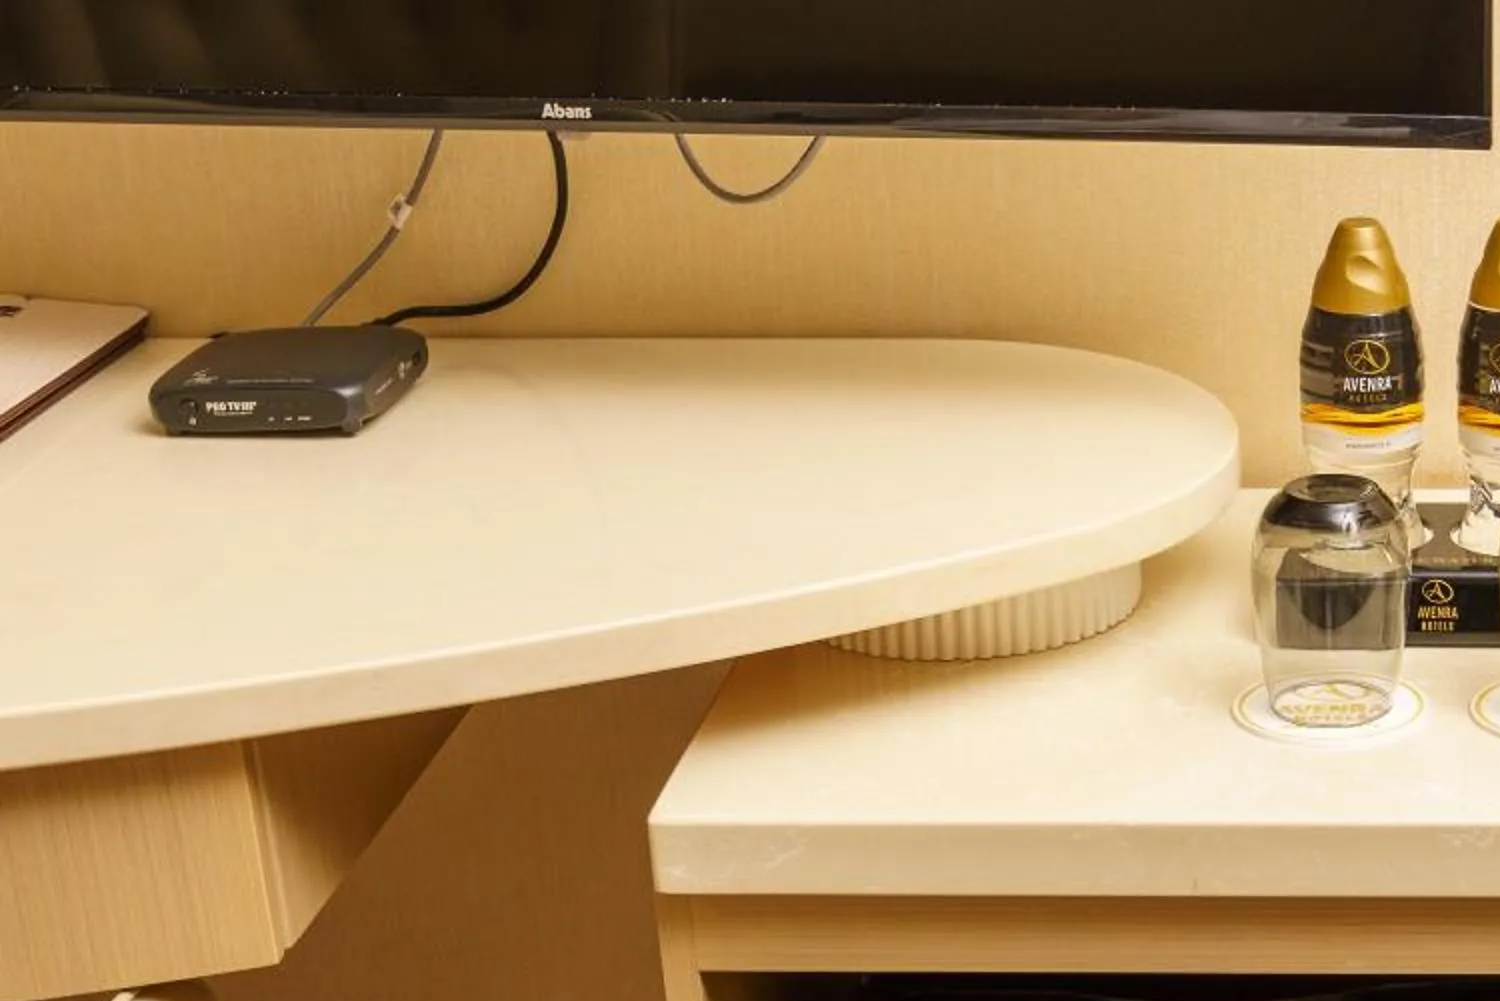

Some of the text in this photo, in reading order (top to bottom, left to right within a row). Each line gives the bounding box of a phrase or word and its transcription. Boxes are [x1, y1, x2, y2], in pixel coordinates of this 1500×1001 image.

[541, 102, 592, 119] Abans
[1343, 376, 1392, 393] AVENRA
[1417, 606, 1459, 619] AVENRA
